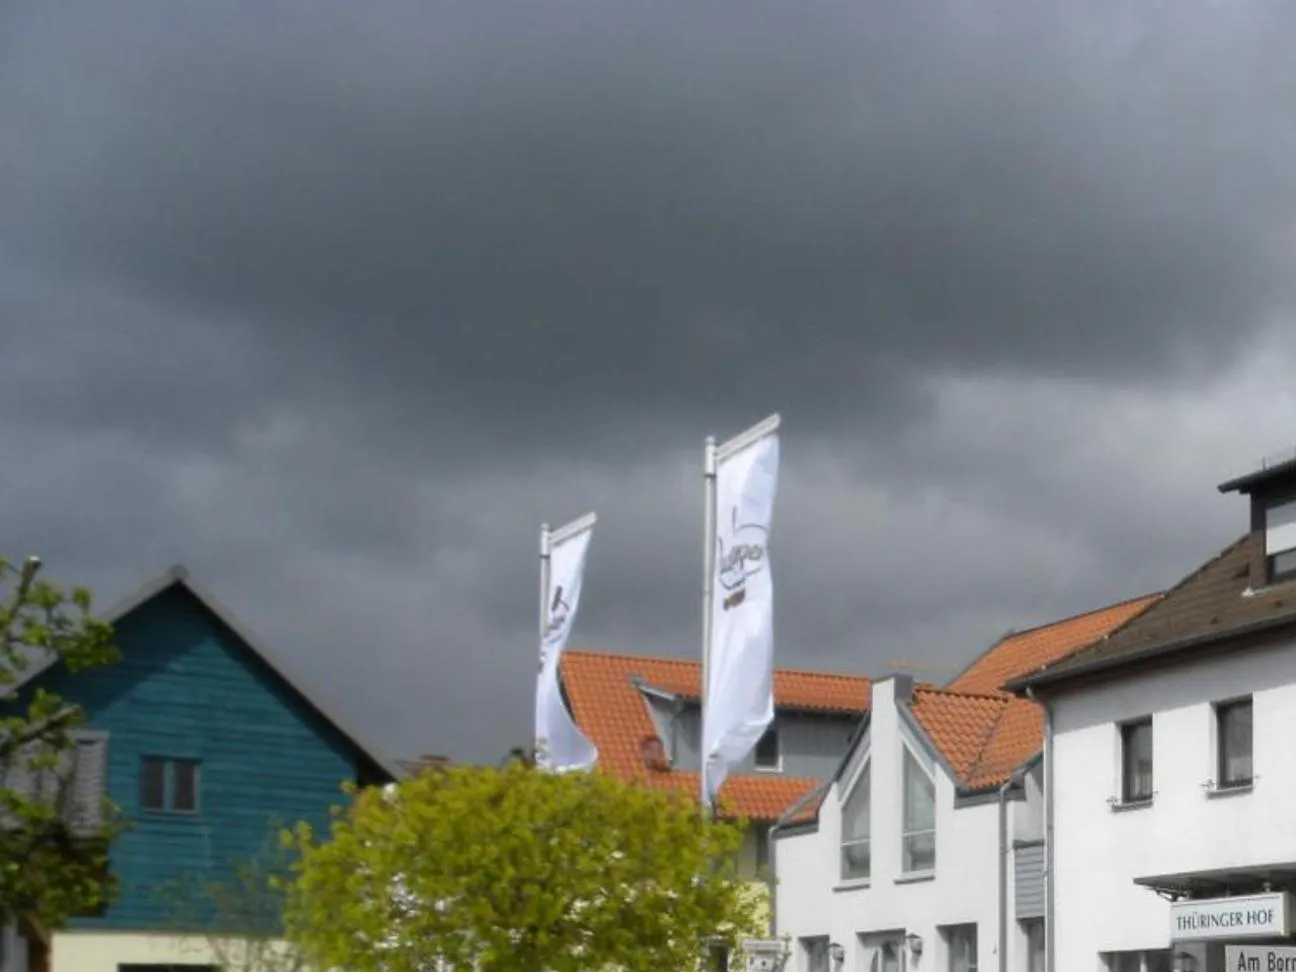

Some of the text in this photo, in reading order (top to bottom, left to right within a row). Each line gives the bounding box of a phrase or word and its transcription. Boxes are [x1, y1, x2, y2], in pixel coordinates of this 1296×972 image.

[1176, 909, 1275, 931] THÜRINGER HOF
[1238, 951, 1260, 972] Am
